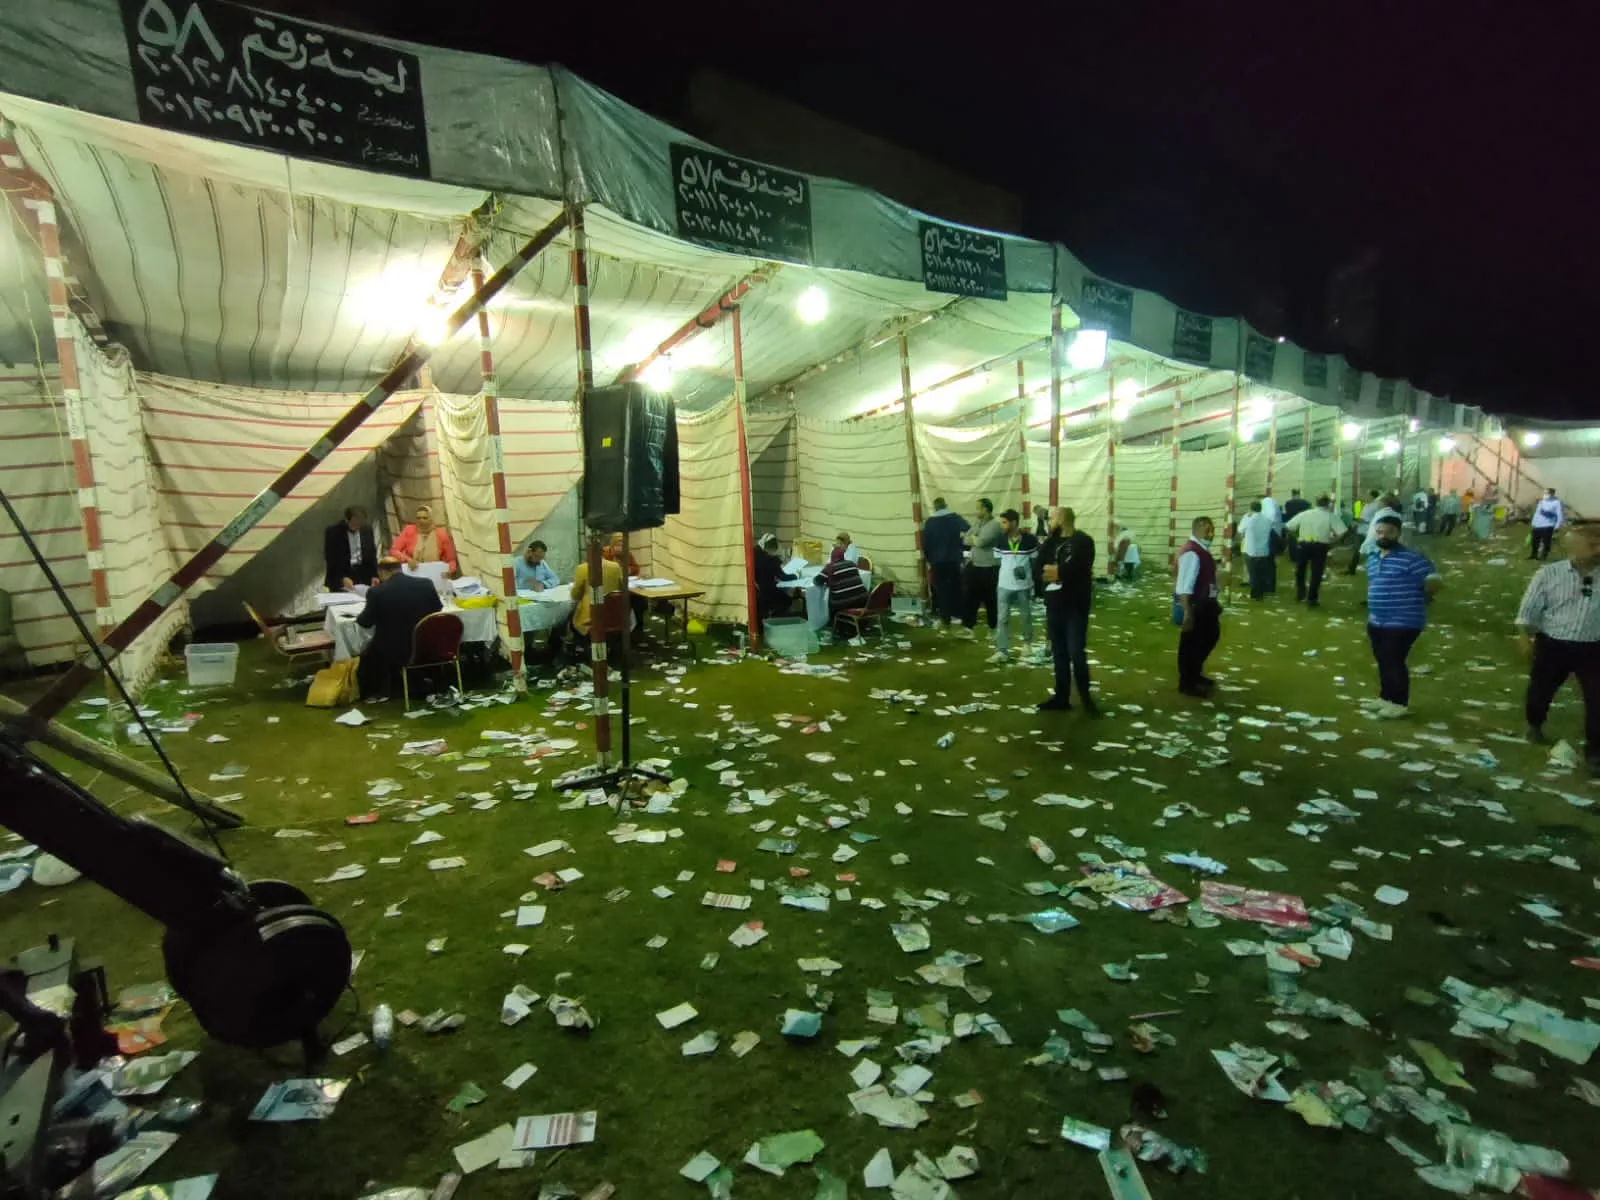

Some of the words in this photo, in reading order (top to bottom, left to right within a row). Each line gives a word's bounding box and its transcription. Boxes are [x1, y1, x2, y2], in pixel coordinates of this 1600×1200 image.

[137, 0, 225, 63] ٥٨
[241, 16, 308, 73] رقم
[308, 32, 409, 99] لجنة
[681, 154, 712, 190] ٥٧
[712, 160, 758, 193] رقم
[756, 167, 805, 206] لجنة
[940, 228, 967, 254] رقم
[966, 234, 1001, 262] لجنة
